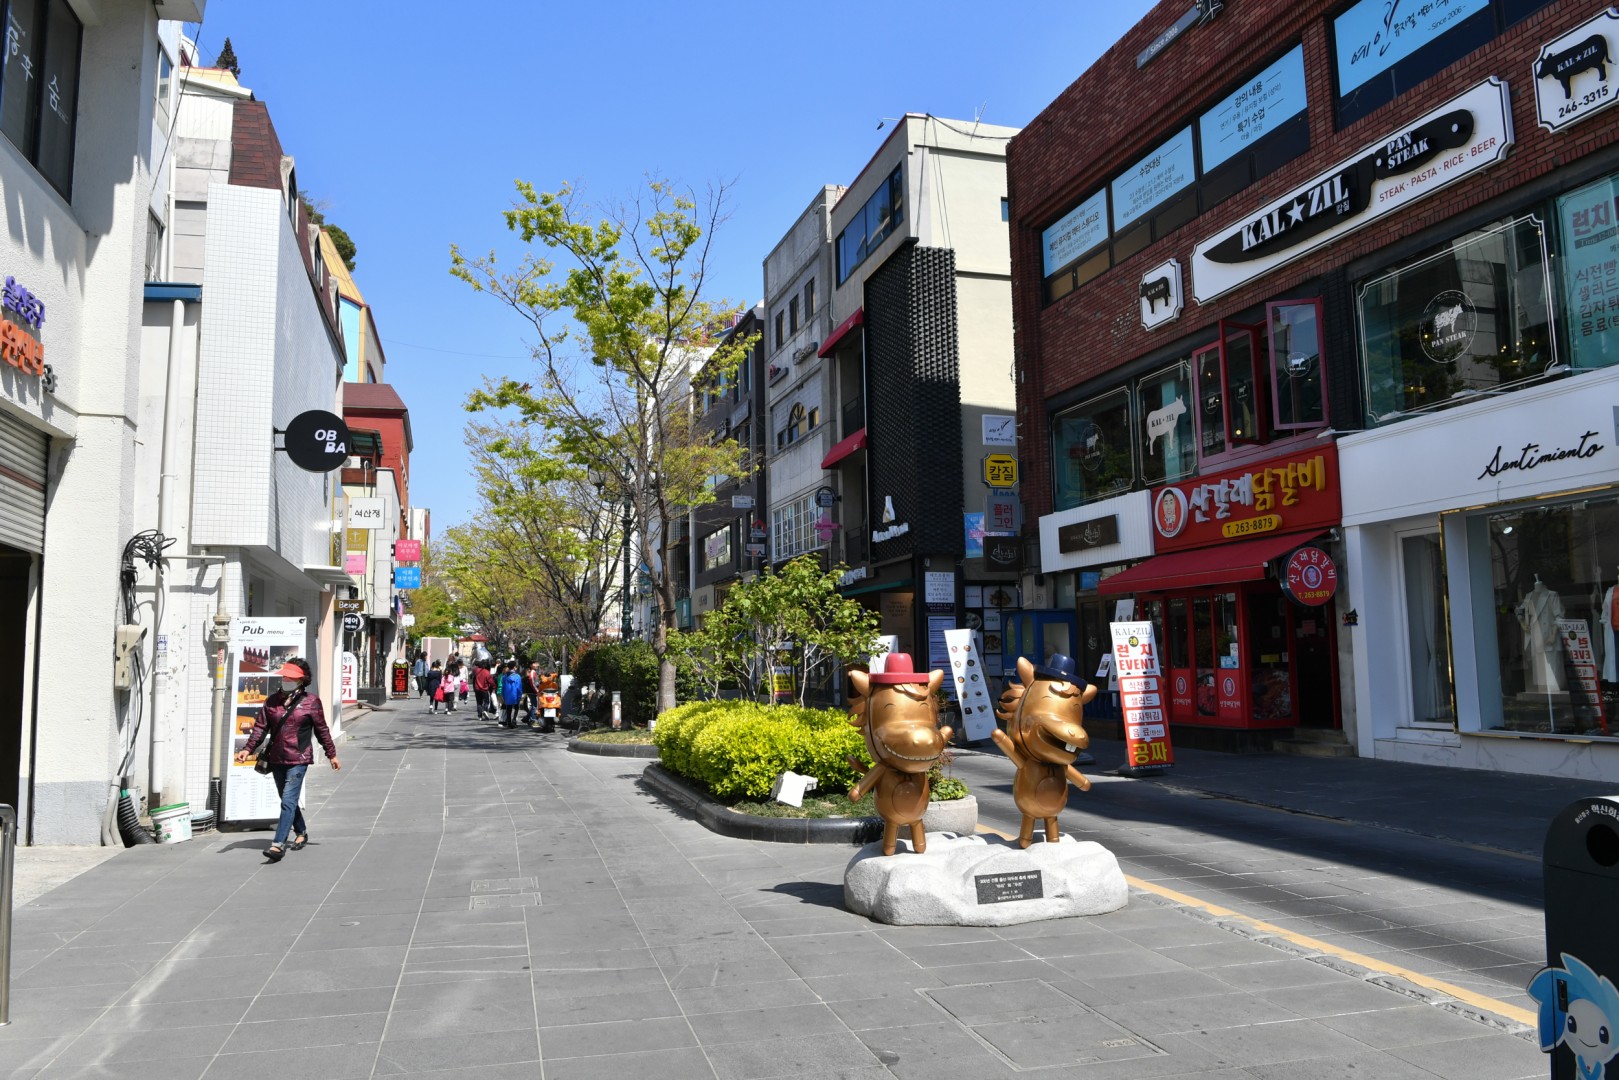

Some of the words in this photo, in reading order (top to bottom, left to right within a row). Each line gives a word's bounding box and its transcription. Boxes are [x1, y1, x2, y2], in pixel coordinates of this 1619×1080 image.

[1150, 41, 1164, 55] Since
[1234, 90, 1248, 108] 강의
[1248, 81, 1263, 97] 내용
[1558, 85, 1609, 118] 246-3315
[1237, 116, 1251, 133] 특기
[1251, 107, 1265, 123] 수업
[1386, 131, 1413, 155] PAN
[1388, 138, 1429, 170] STEAK
[1379, 182, 1406, 202] STEAK
[1410, 168, 1437, 187] PASTA
[1443, 152, 1465, 172] RICE
[1470, 137, 1496, 158] BEER
[1572, 200, 1610, 237] 런치
[1577, 259, 1618, 283] 식전빵
[1578, 277, 1619, 301] 샐러드
[1431, 338, 1444, 348] PAN
[1445, 331, 1467, 344] STEAK
[1477, 430, 1605, 480] Sentimiento
[989, 465, 1014, 481] 칼질
[993, 503, 1013, 515] 플러
[993, 517, 1013, 529] 그인
[338, 602, 360, 611] Beige
[242, 625, 265, 635] Pub
[1119, 658, 1155, 671] EVENT
[1128, 680, 1151, 690] 식전빵
[1130, 710, 1160, 721] 감자튀김
[1133, 741, 1168, 764] 공짜
